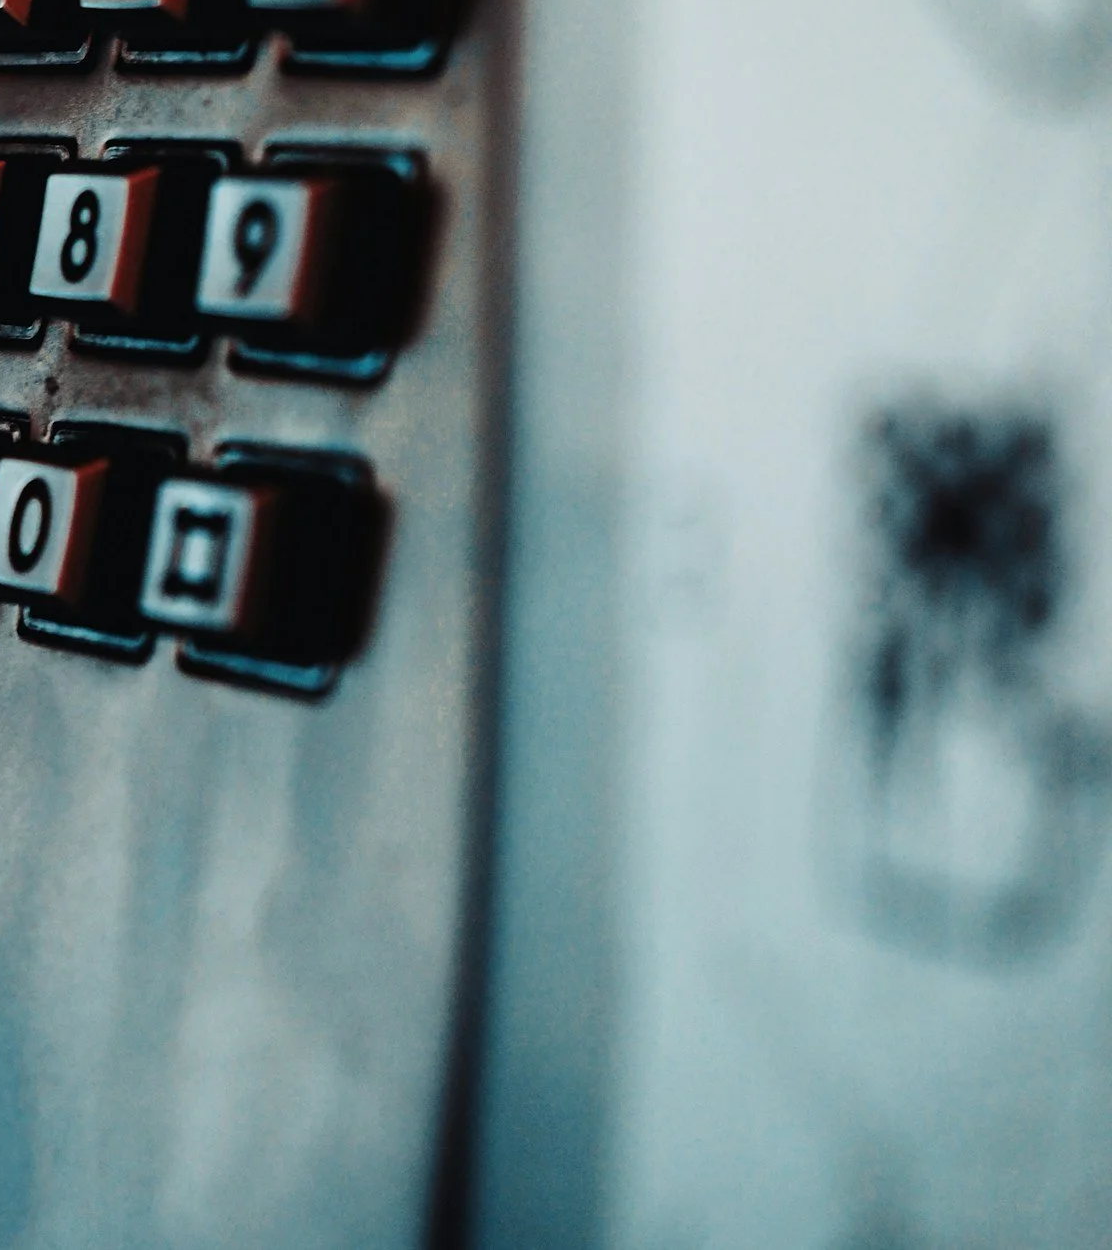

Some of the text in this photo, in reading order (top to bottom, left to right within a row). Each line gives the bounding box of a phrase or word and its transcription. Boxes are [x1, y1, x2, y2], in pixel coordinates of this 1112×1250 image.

[59, 188, 100, 284] 8
[233, 198, 280, 299] 9
[8, 477, 52, 574] 0
